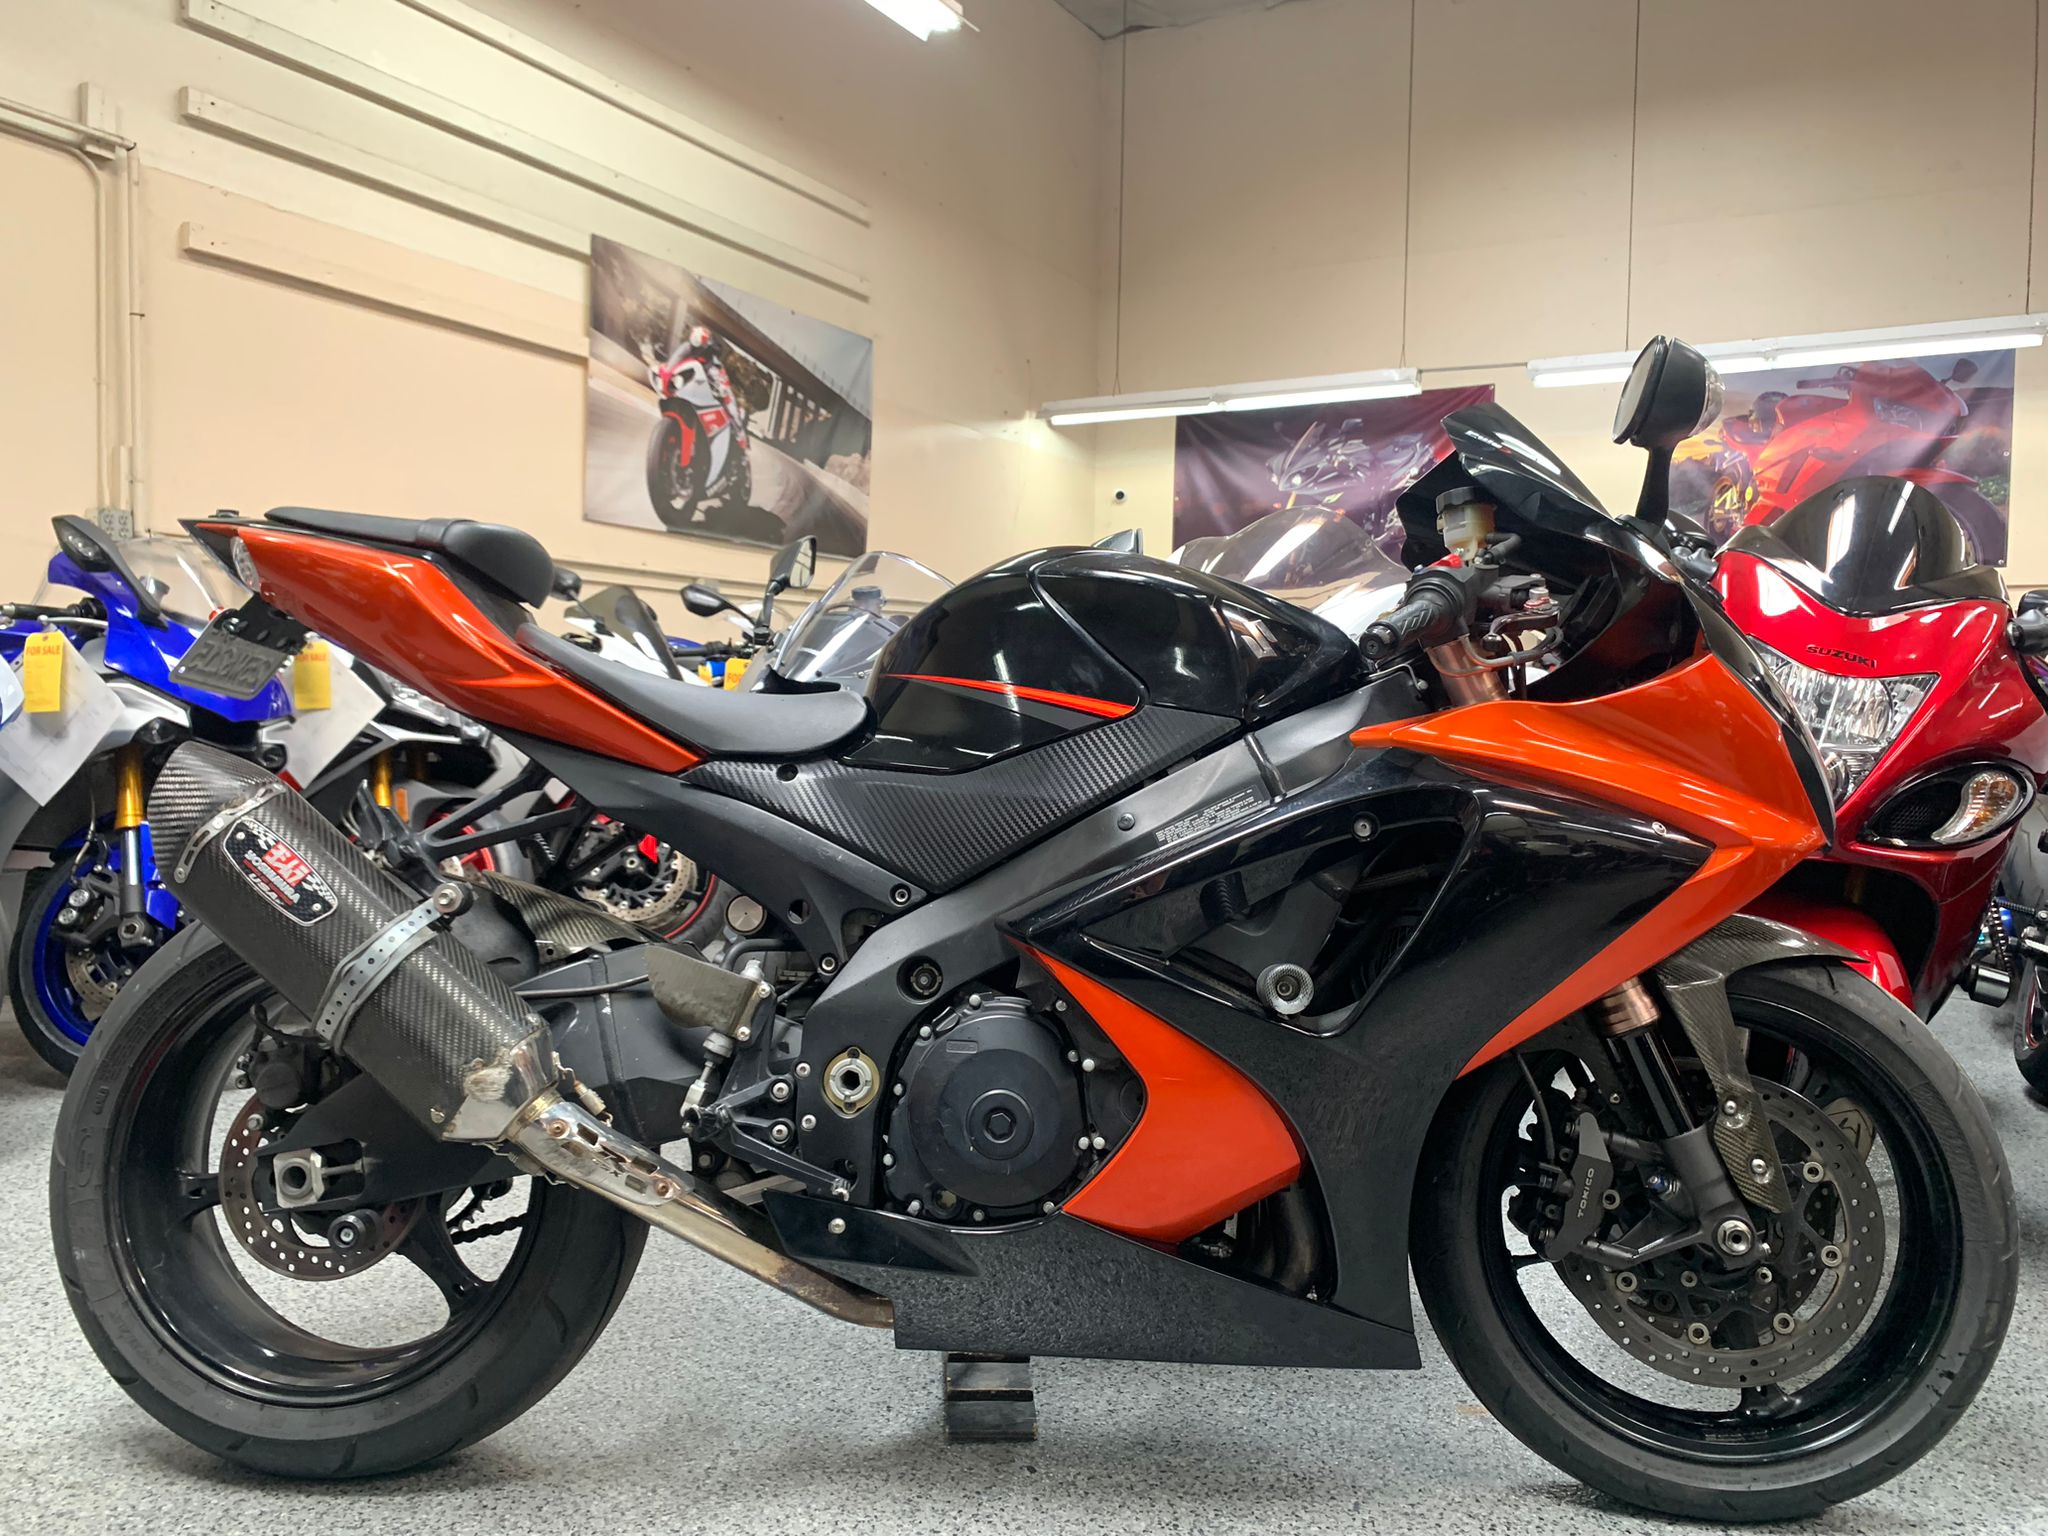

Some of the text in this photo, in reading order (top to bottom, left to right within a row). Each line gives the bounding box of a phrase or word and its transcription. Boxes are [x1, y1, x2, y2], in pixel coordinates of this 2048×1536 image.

[26, 645, 60, 656] FOR SALE
[1807, 646, 1876, 669] SUZUKI
[244, 849, 301, 904] YOSHIMURA
[248, 872, 279, 901] USA
[1577, 1167, 1595, 1218] TOKICO
